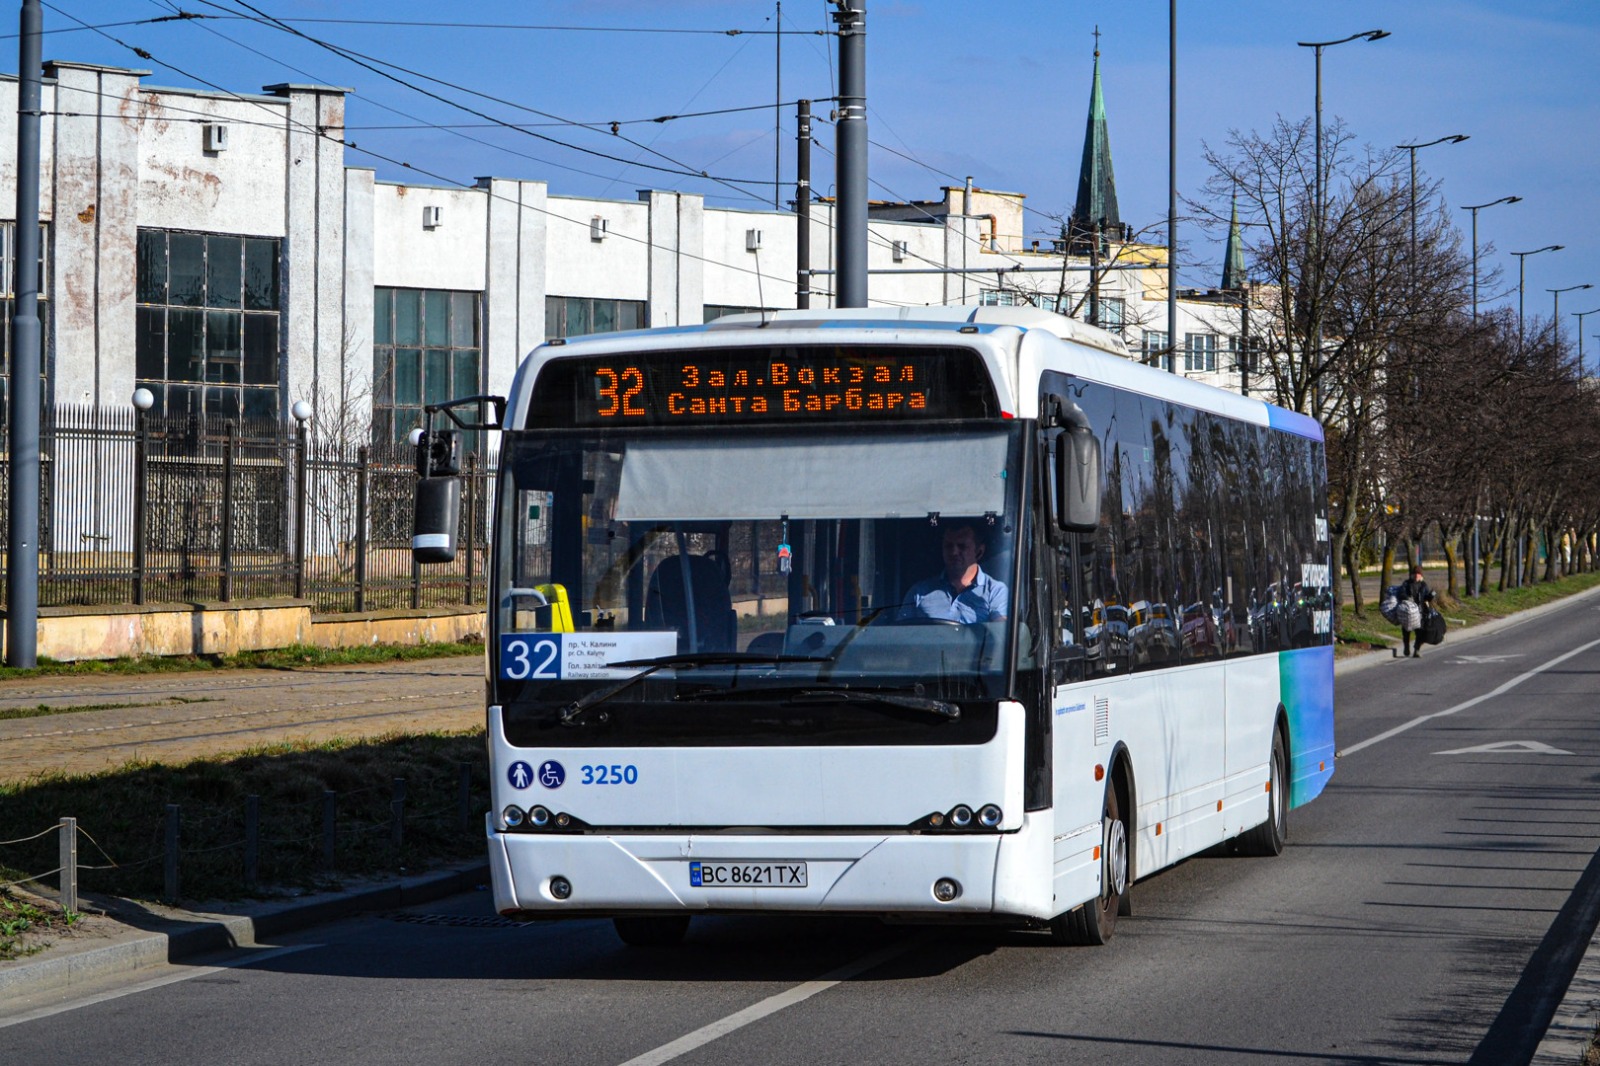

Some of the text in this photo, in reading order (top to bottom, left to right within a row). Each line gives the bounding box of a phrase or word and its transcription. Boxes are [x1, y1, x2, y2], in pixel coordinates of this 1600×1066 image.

[596, 367, 645, 417] 32
[668, 388, 926, 415] Санта Барбара
[569, 642, 579, 650] пр.
[506, 639, 557, 680] 32
[580, 764, 638, 785] 3250
[701, 866, 802, 883] BC 8621 TX
